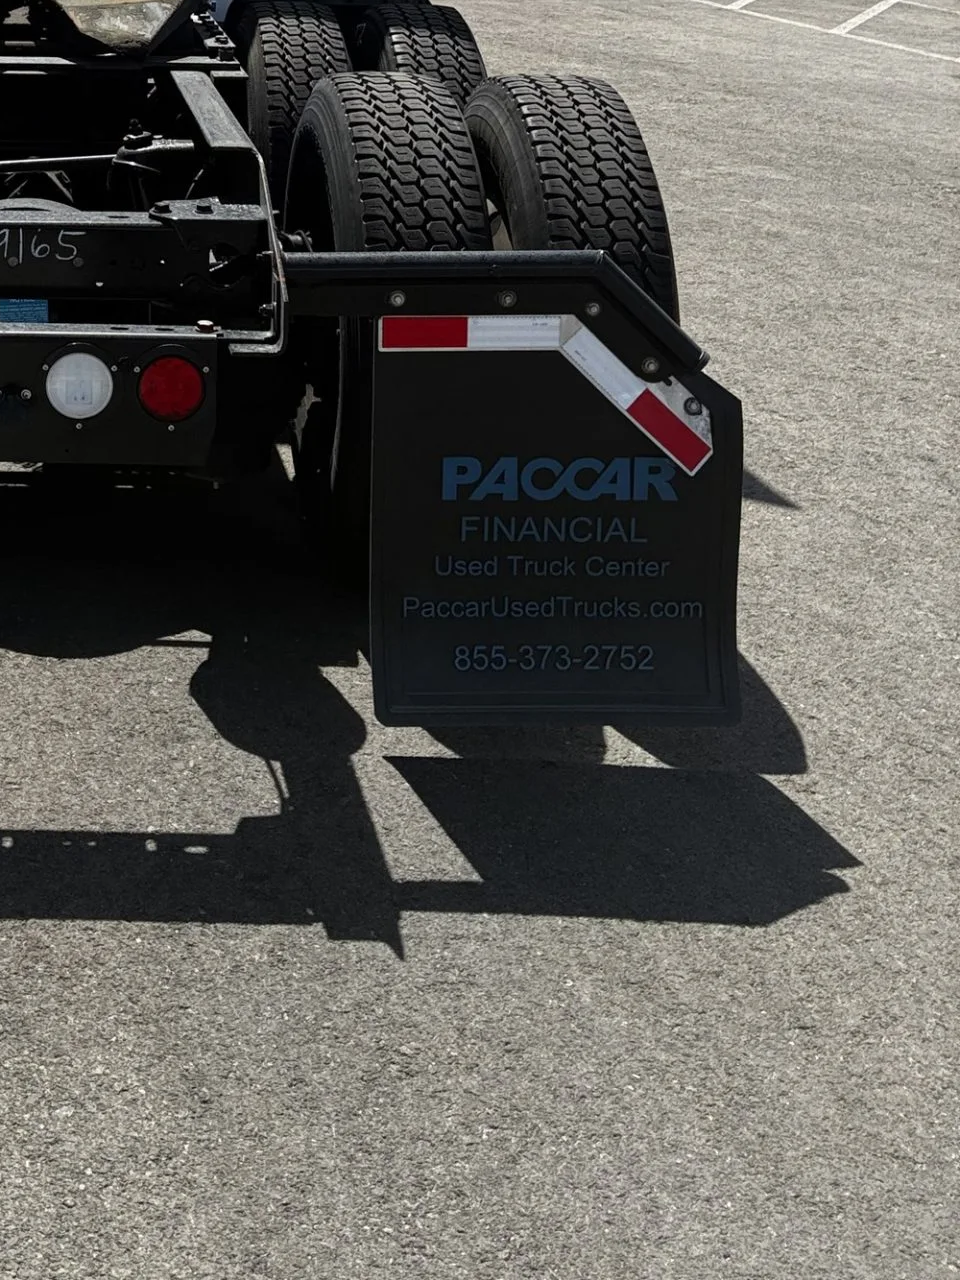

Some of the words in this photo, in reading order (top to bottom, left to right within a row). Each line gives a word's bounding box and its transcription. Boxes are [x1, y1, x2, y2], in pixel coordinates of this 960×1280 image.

[442, 457, 678, 501] PACCAR
[461, 516, 648, 543] FINANCIAL
[435, 556, 498, 576] Used
[507, 556, 576, 576] Truck
[585, 556, 670, 576] Center
[402, 596, 703, 618] PaccarUsedTrucks.com
[454, 645, 655, 670] 855-373-2752
